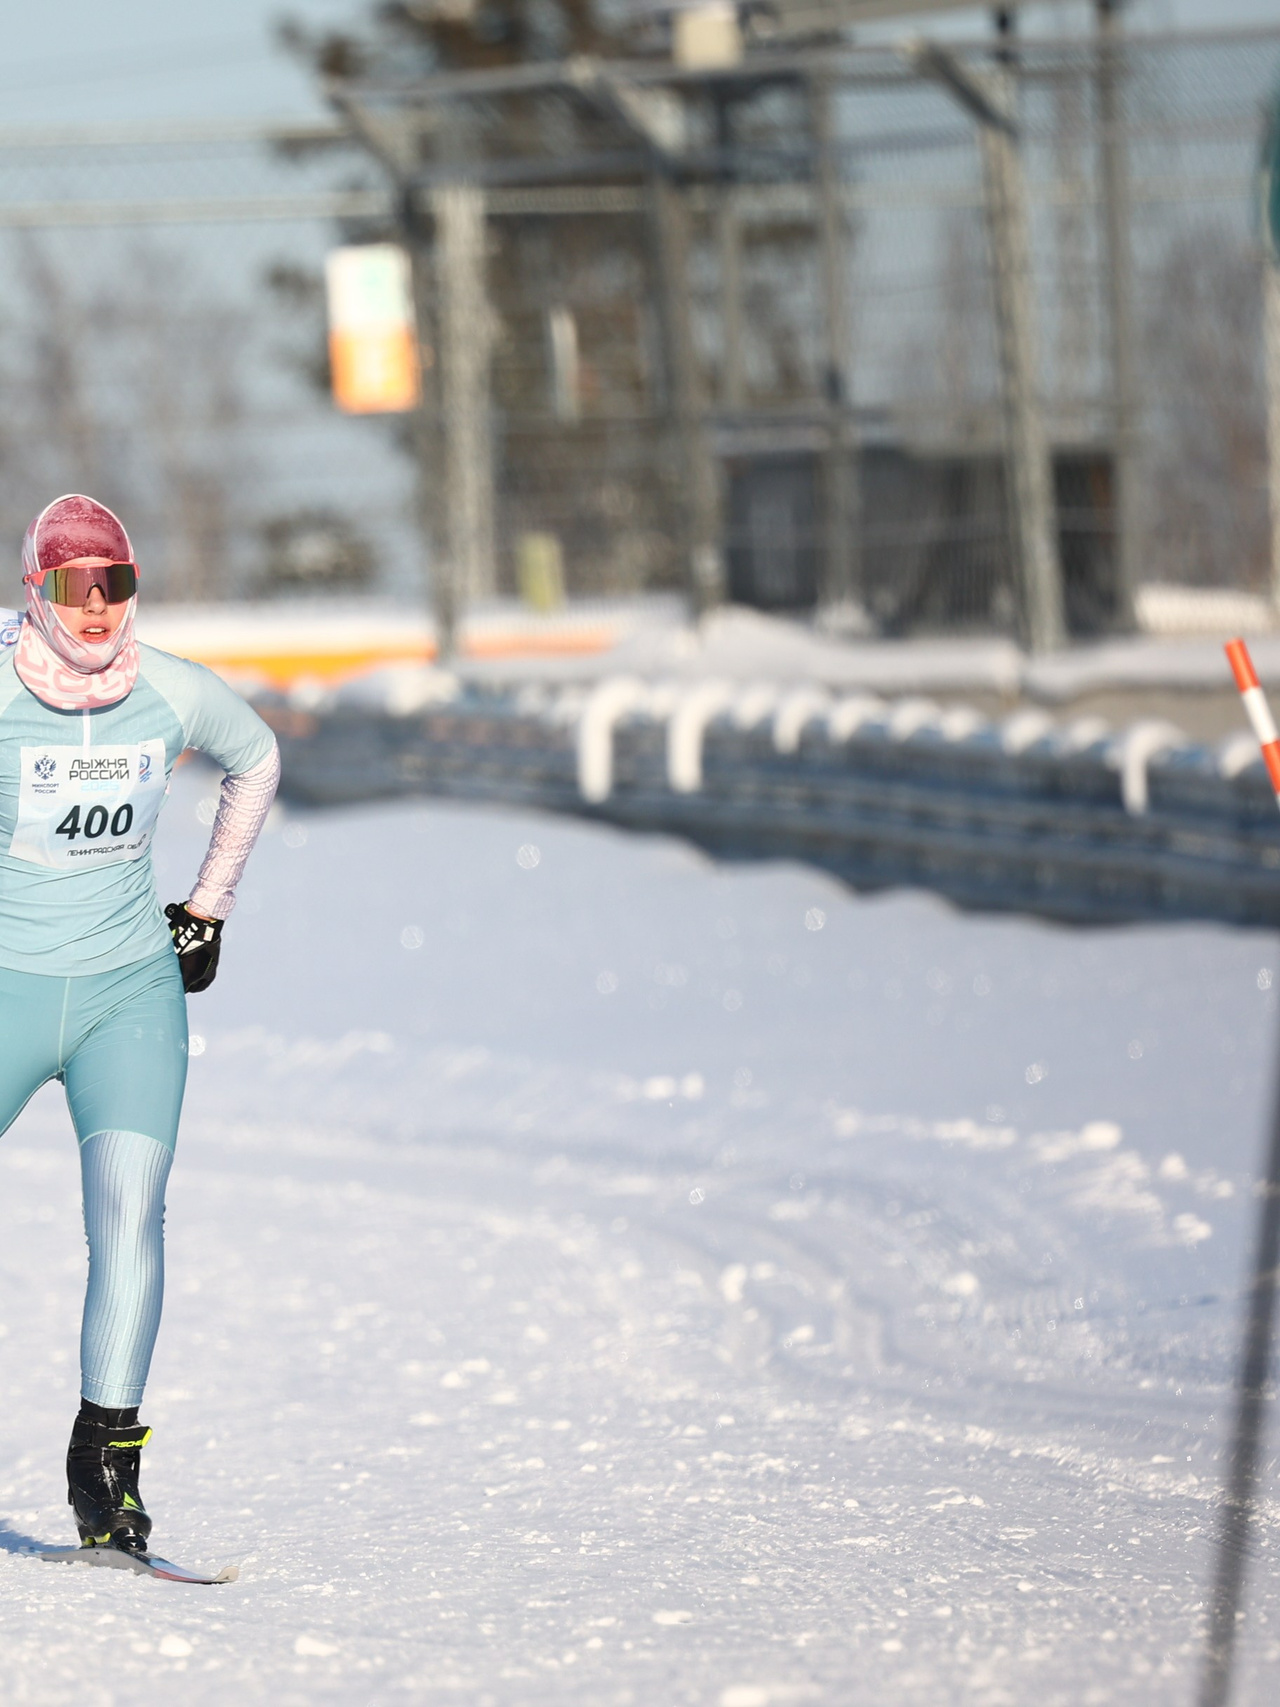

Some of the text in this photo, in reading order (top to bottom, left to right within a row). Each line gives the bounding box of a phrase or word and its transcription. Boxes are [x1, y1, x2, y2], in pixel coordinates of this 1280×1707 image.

[71, 758, 128, 769] ЛЫЖНЯ
[69, 769, 130, 781] РОССИИ
[81, 781, 120, 792] 2025
[55, 803, 134, 840] 400
[67, 844, 125, 856] ЛЕНИНГРАДСКАЯ
[173, 922, 199, 955] LEKI
[108, 1440, 143, 1448] FISCHE
